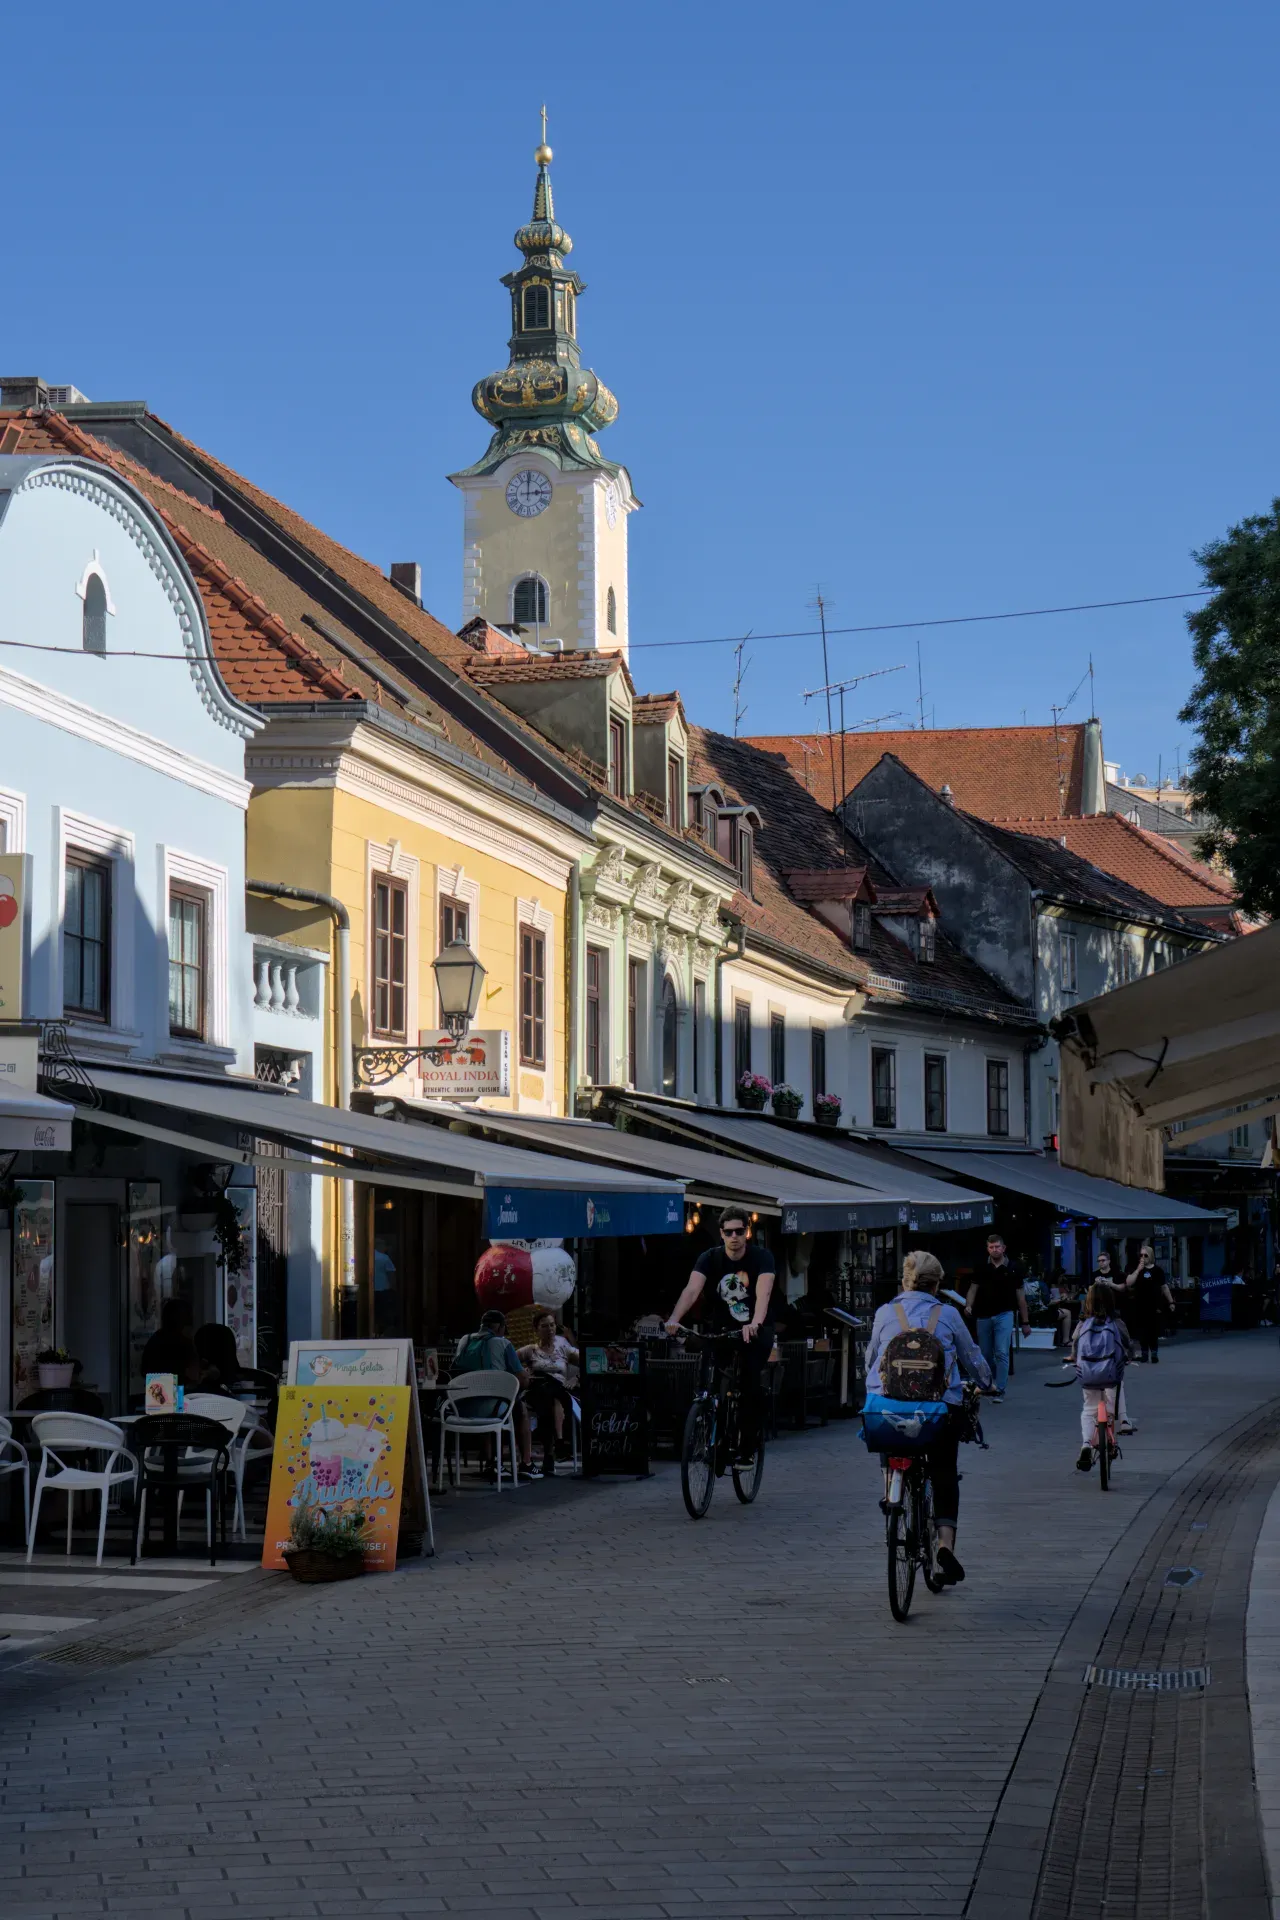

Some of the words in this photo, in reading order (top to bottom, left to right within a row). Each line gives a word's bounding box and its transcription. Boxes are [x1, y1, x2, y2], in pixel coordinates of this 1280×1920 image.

[423, 1071, 460, 1081] ROYAL
[463, 1071, 500, 1081] INDIA
[1201, 1277, 1232, 1289] EXCHANGE
[591, 1411, 640, 1436] Gelato
[291, 1475, 396, 1509] Bubble
